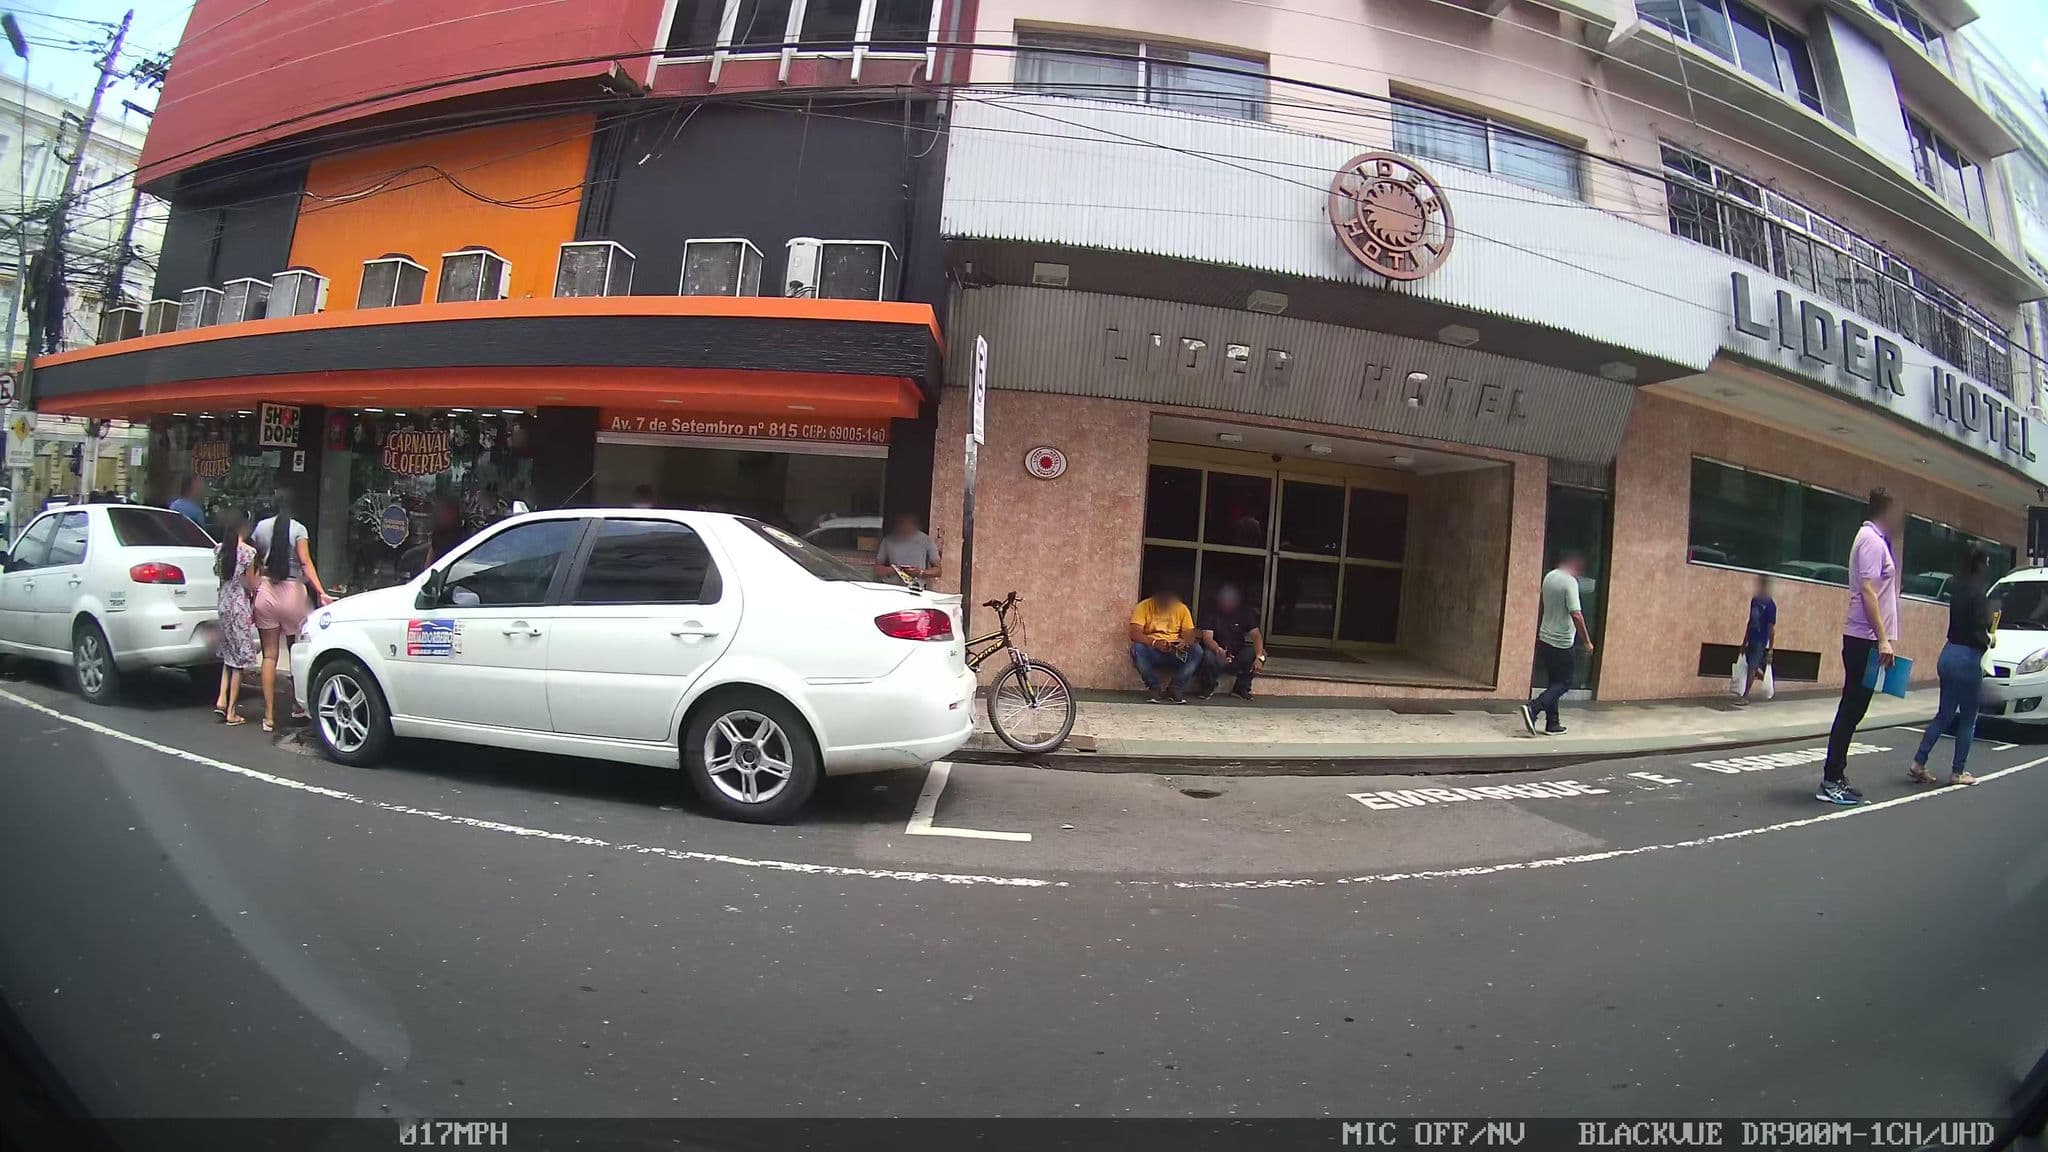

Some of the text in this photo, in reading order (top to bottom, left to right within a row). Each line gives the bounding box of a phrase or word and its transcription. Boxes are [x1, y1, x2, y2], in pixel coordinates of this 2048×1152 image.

[1731, 271, 2036, 463] LIDER HOTEL
[263, 425, 300, 442] DOPE
[389, 431, 449, 453] CARNAVAL
[611, 416, 632, 430] Av.
[636, 416, 646, 430] 7
[649, 418, 667, 431] de
[671, 418, 744, 435] Setembro
[768, 422, 799, 437] 815
[802, 424, 826, 439] CEP:
[829, 426, 886, 443] 69005-140
[384, 449, 451, 474] DE OFERTAS
[1346, 780, 1611, 810] EMBARQUE
